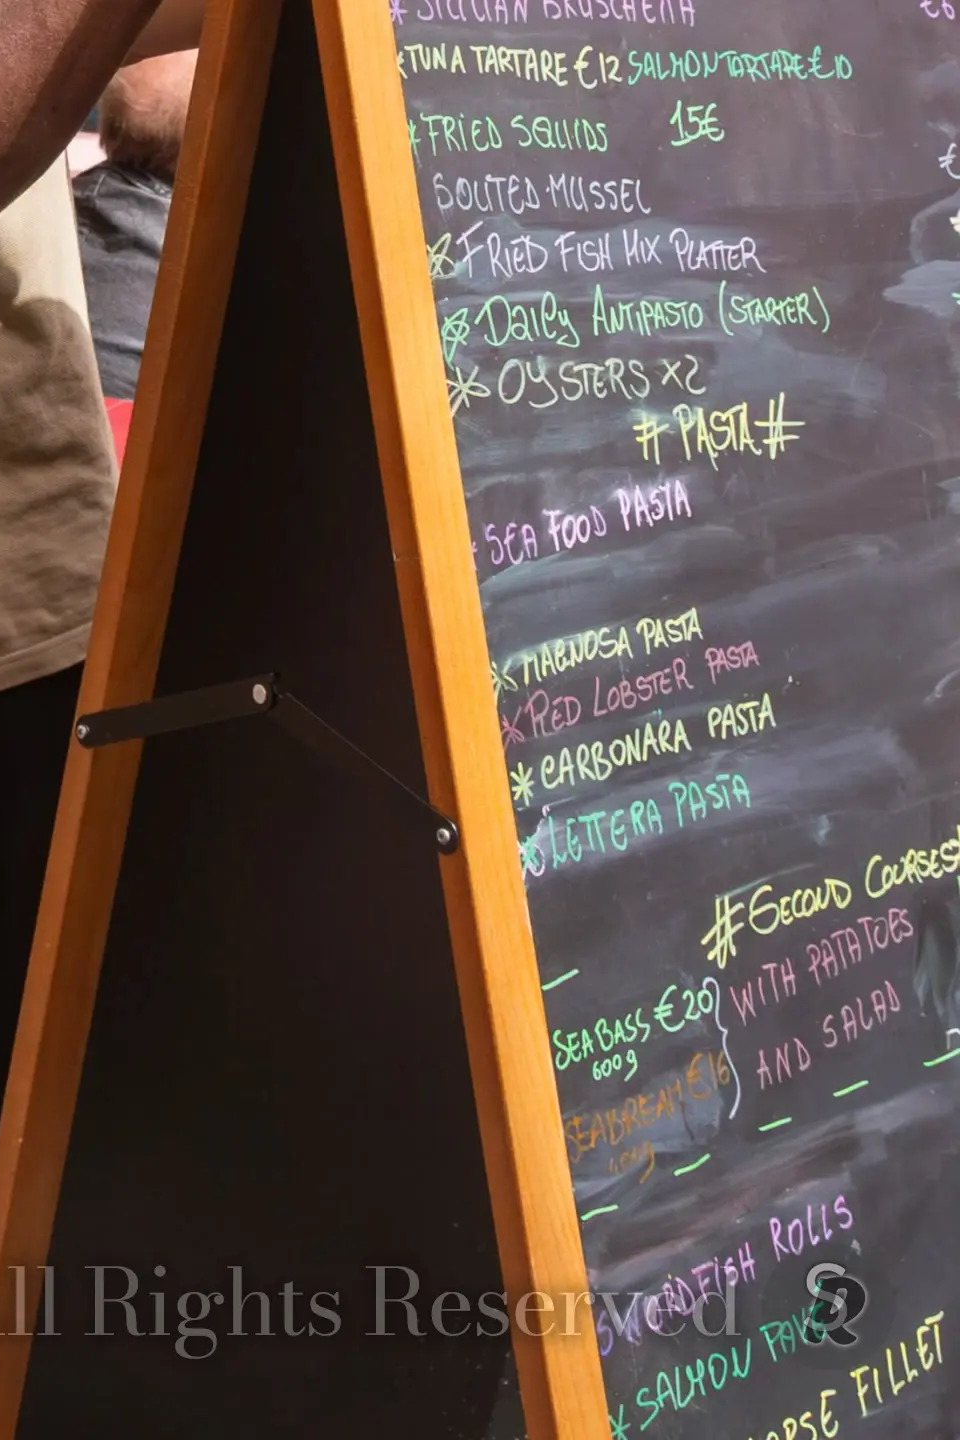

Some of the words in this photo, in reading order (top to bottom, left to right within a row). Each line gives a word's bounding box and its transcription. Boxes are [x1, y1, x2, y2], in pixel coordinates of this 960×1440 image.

[404, 43, 466, 75] TUNA
[469, 44, 568, 87] TARTARE
[628, 49, 719, 85] SALMON
[719, 48, 808, 82] TARTARE
[420, 112, 502, 156] FRIED
[511, 114, 608, 152] SQUIDS
[670, 99, 724, 146] 15€
[433, 173, 540, 214] SOUTED
[456, 221, 548, 278] FRIED
[554, 227, 610, 272] FISH
[622, 227, 662, 266] MIX
[669, 227, 766, 273] PLATTER
[592, 283, 703, 336] ANTIPASTO
[718, 280, 830, 335] (STARTER)
[498, 356, 650, 408] OYSTERS
[484, 522, 539, 565] SEA
[542, 506, 607, 552] FOOD
[618, 479, 693, 532] PASTA
[522, 626, 633, 686] MAGNOSA
[636, 606, 704, 655] PASTA
[524, 689, 582, 738] RED
[593, 657, 694, 717] LOBSTER
[704, 640, 760, 685] PASTA
[540, 718, 692, 790] CARBONARA
[707, 692, 777, 740] PASTA
[548, 798, 664, 869] LETTERA
[668, 773, 751, 828] PASTA
[653, 984, 714, 1033] €20
[729, 958, 797, 1026] WITH
[806, 907, 914, 987] PATATOES
[756, 1036, 812, 1090] AND
[822, 979, 901, 1048] SALAD
[596, 1242, 756, 1357] SWORDFISH
[769, 1194, 854, 1261] ROLLS
[636, 1338, 752, 1431] SALMON
[849, 1310, 944, 1417] FILLET
